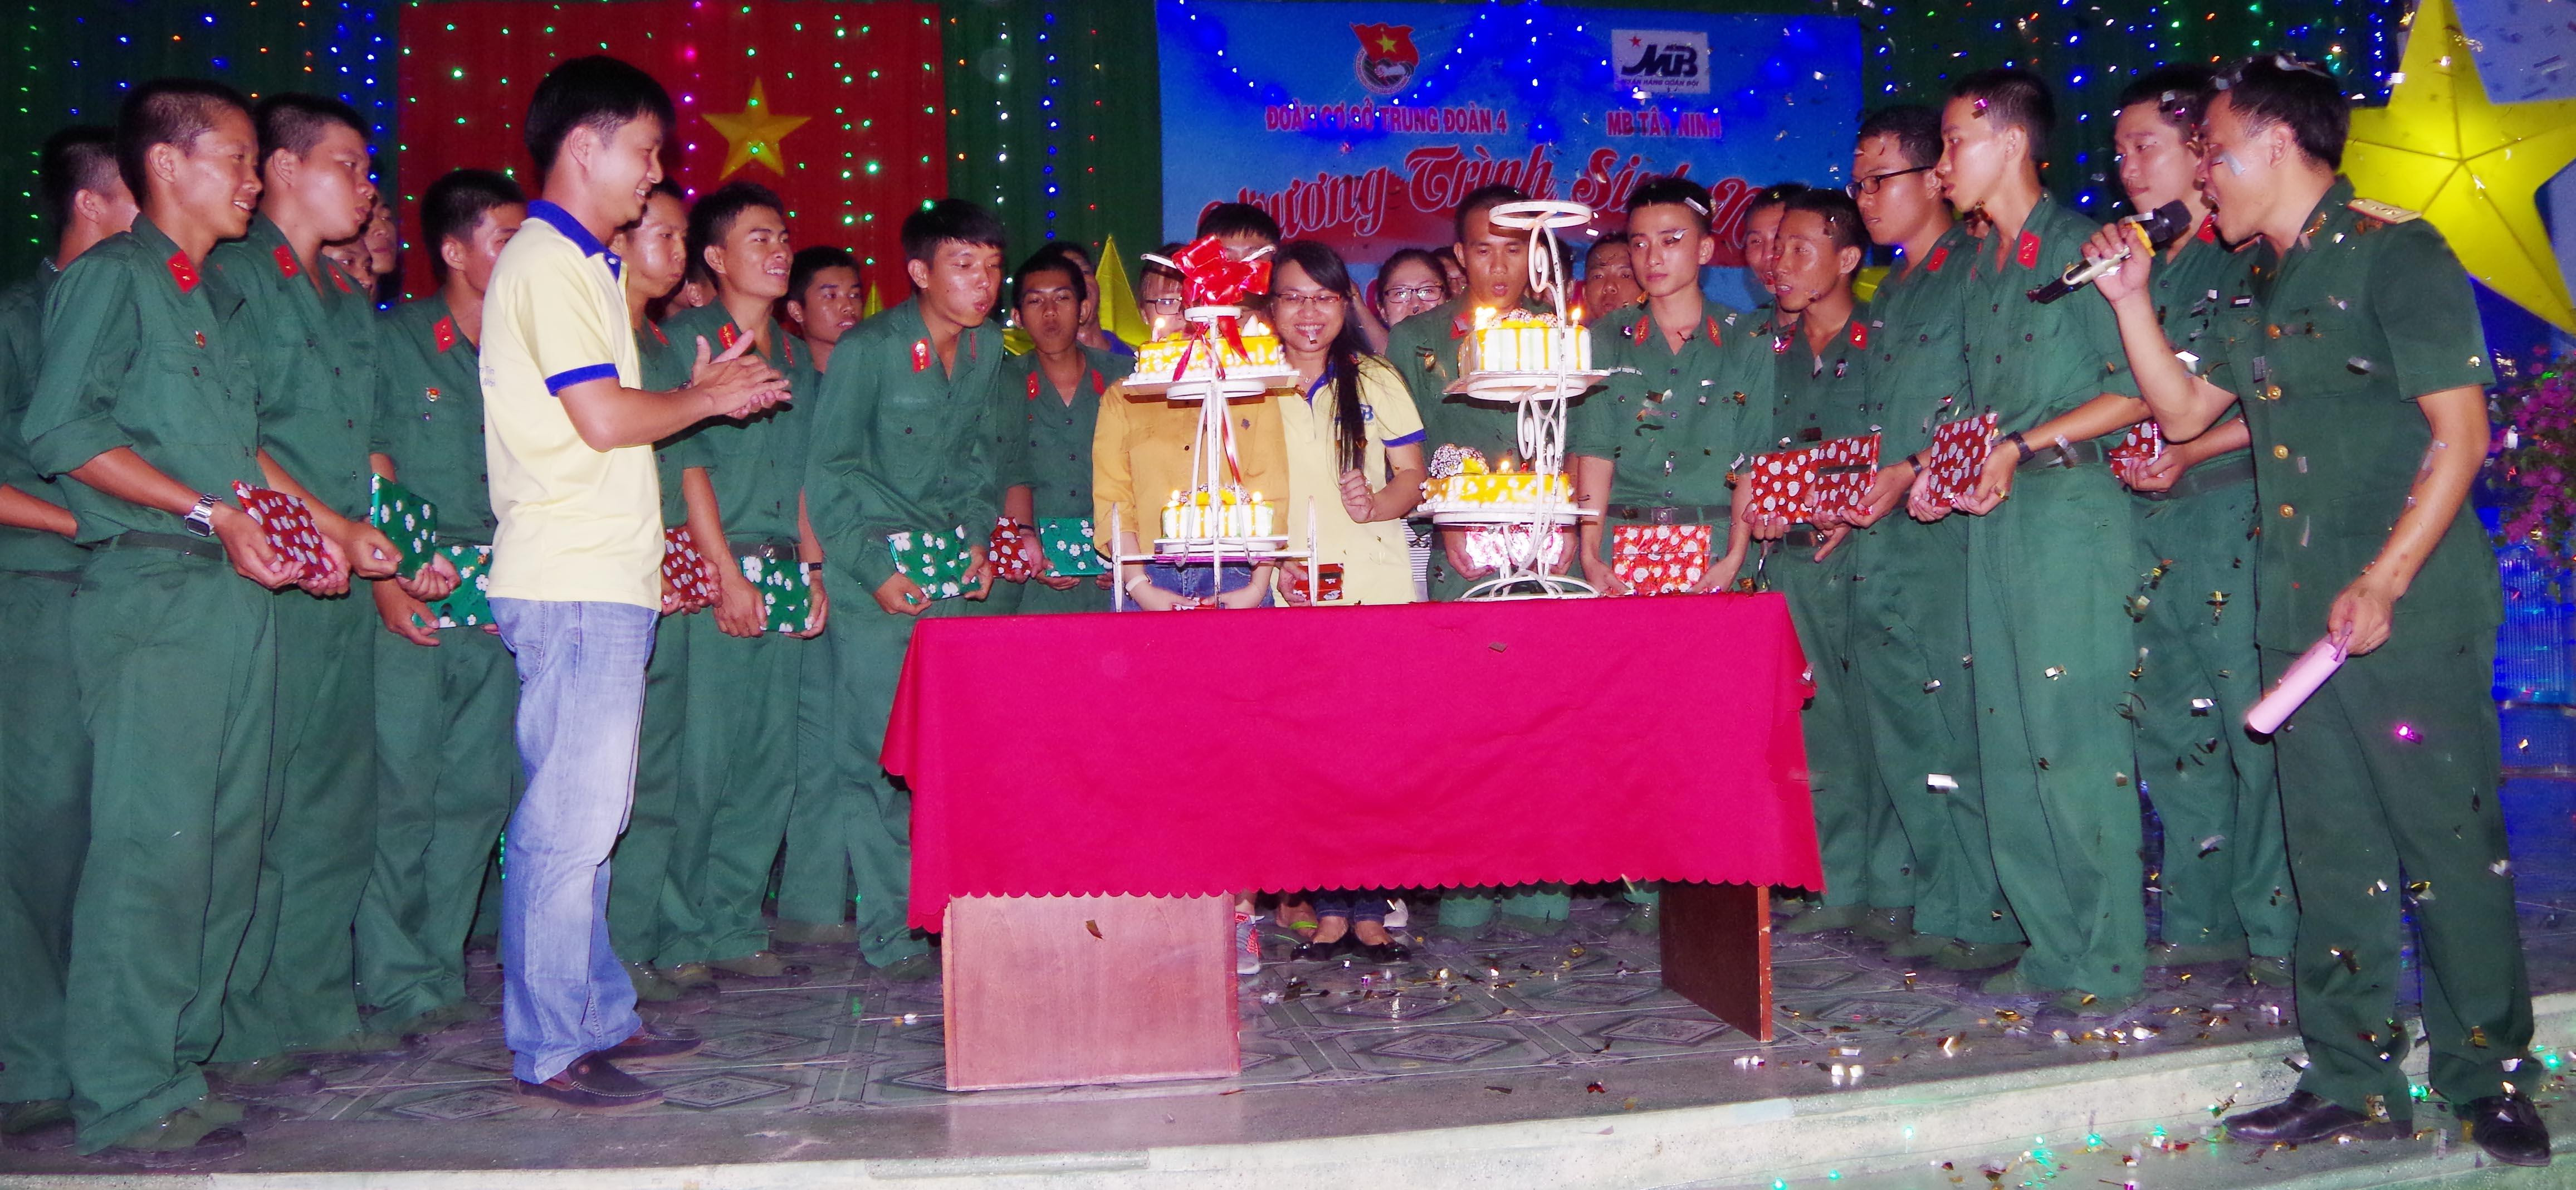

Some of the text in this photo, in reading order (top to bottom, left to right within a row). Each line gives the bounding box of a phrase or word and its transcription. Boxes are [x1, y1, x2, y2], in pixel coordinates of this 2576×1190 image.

[1621, 44, 1698, 77] MB
[1266, 99, 1317, 131] ĐOÀN
[1348, 97, 1375, 131] SỞ
[1379, 106, 1439, 133] TRUNG
[1442, 101, 1493, 133] ĐOÀN
[1495, 109, 1507, 133] 4
[1606, 110, 1635, 136] MB
[1677, 112, 1722, 138] NINH
